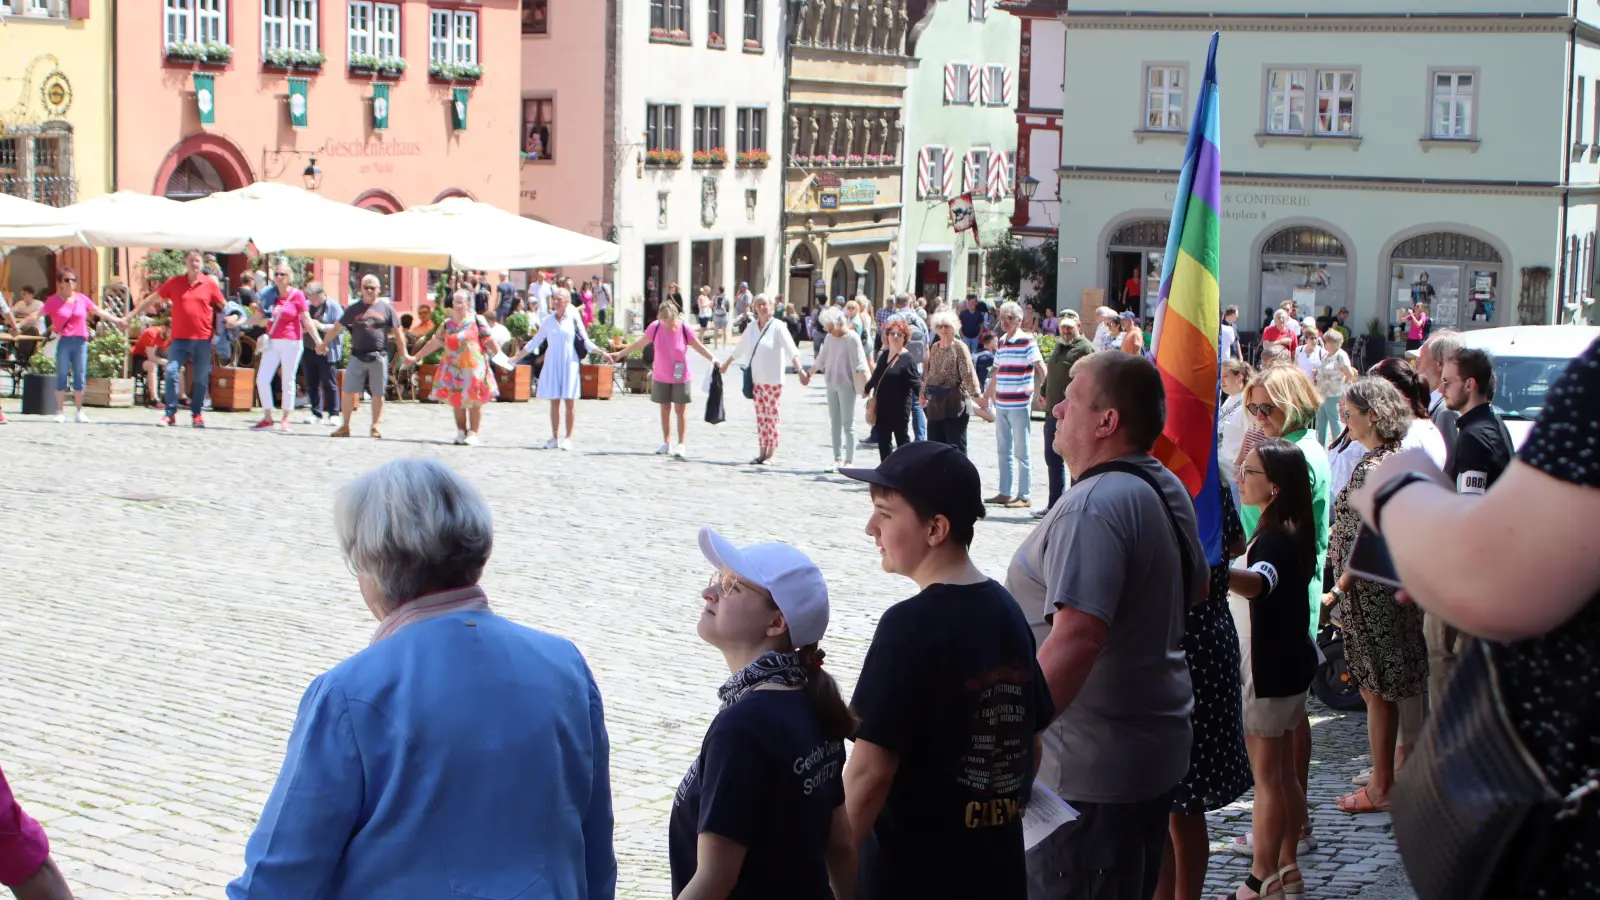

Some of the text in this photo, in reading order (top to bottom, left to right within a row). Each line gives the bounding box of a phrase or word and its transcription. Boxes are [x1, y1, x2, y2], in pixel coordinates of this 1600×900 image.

[324, 138, 420, 156] Geschenkehaus
[1223, 194, 1310, 206] & CONFISERIE
[1260, 564, 1277, 588] ORD
